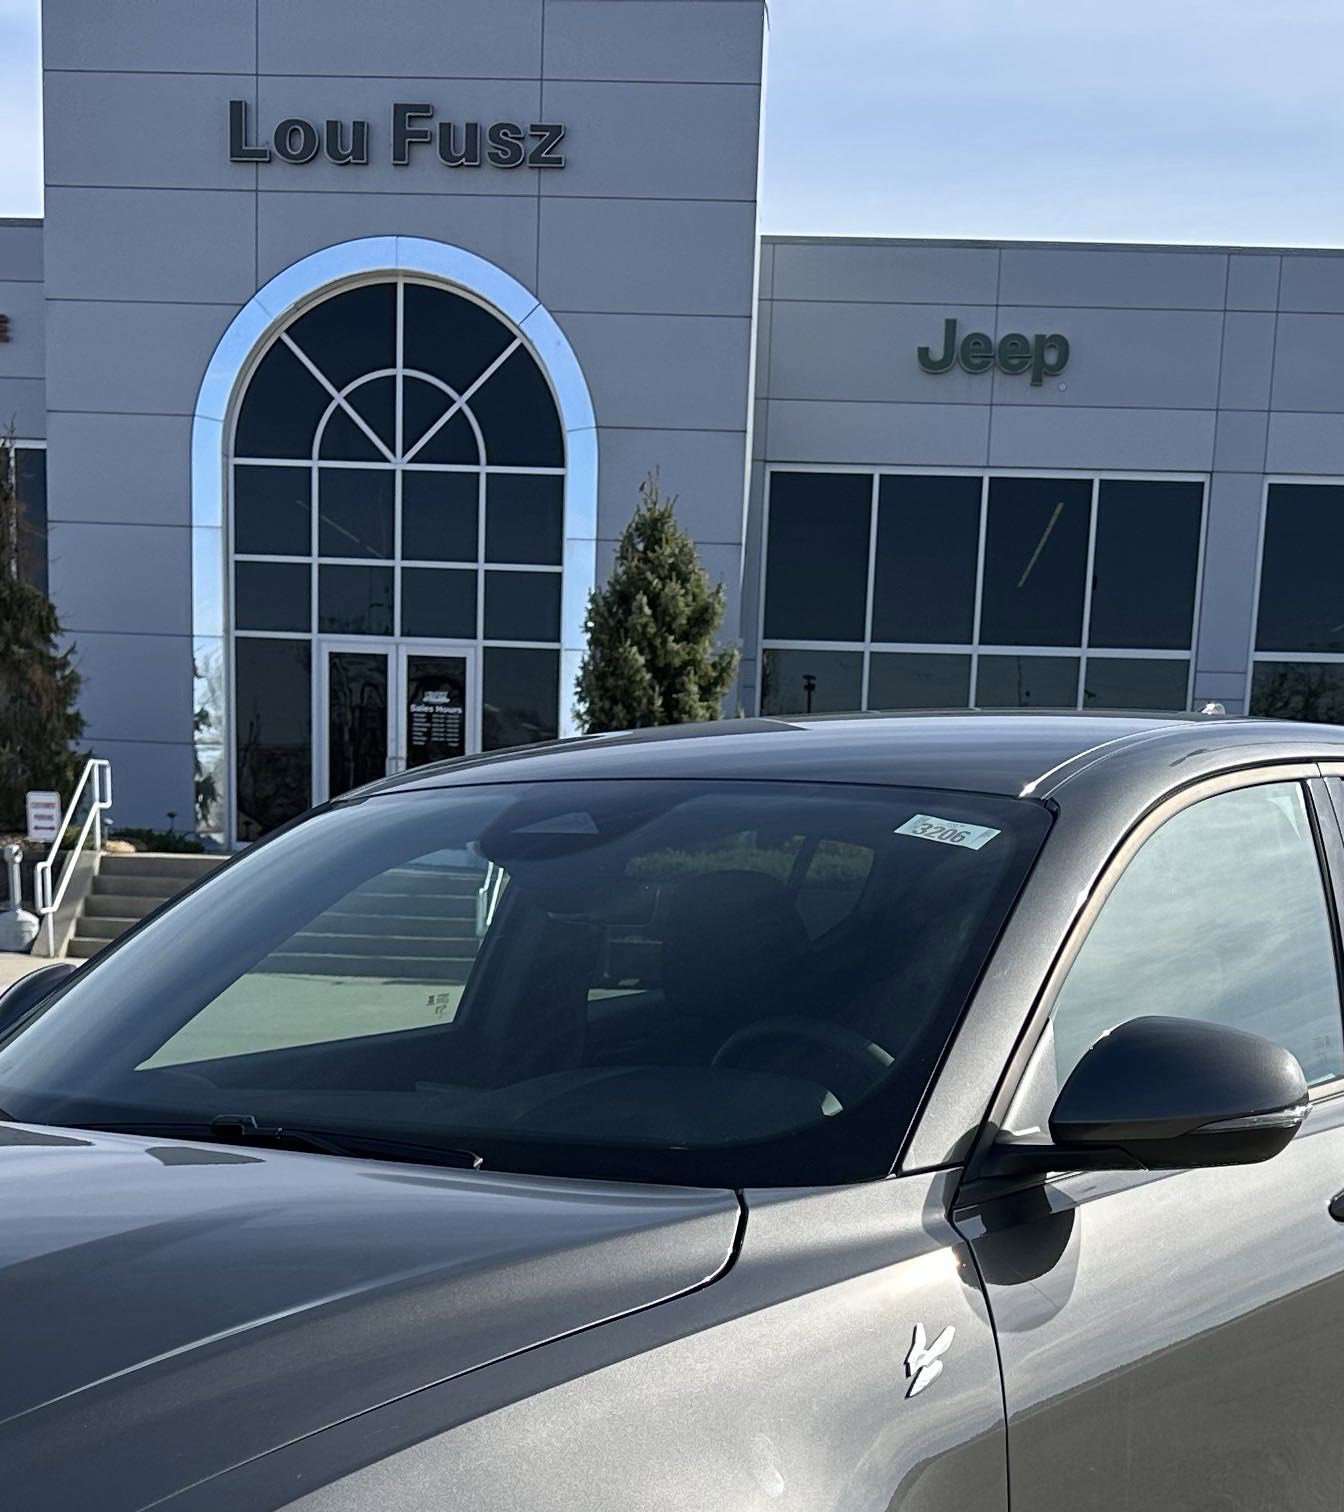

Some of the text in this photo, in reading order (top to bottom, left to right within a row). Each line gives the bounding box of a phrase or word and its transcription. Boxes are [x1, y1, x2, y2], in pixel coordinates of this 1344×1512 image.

[228, 100, 566, 168] Lou Fusz
[917, 318, 1071, 387] Jeep
[912, 823, 972, 843] 3206
